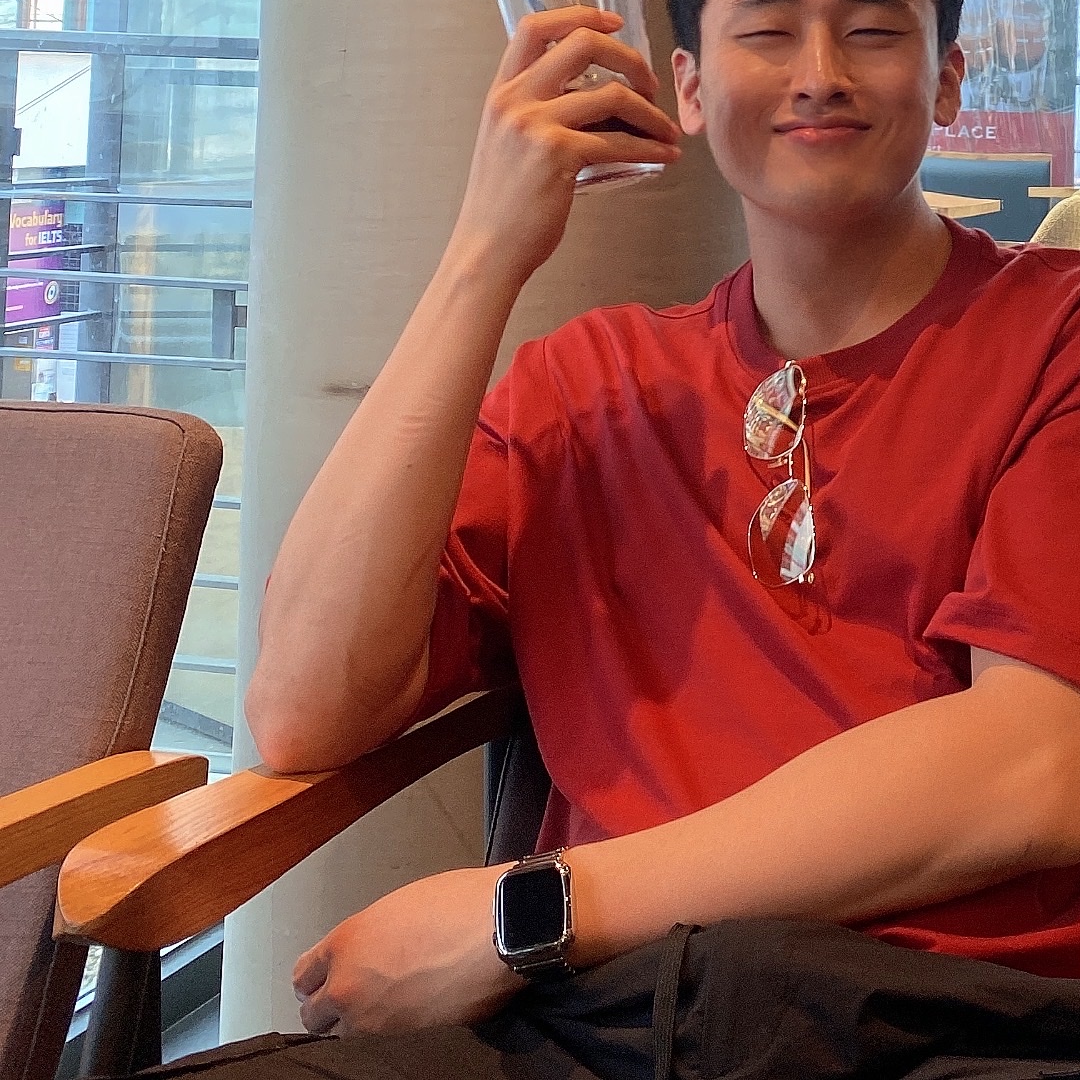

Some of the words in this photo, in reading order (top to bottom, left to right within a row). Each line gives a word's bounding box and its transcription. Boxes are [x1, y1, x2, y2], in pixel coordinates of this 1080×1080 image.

[11, 209, 64, 228] Vocabulary
[25, 232, 37, 246] for
[38, 230, 63, 244] IELTS
